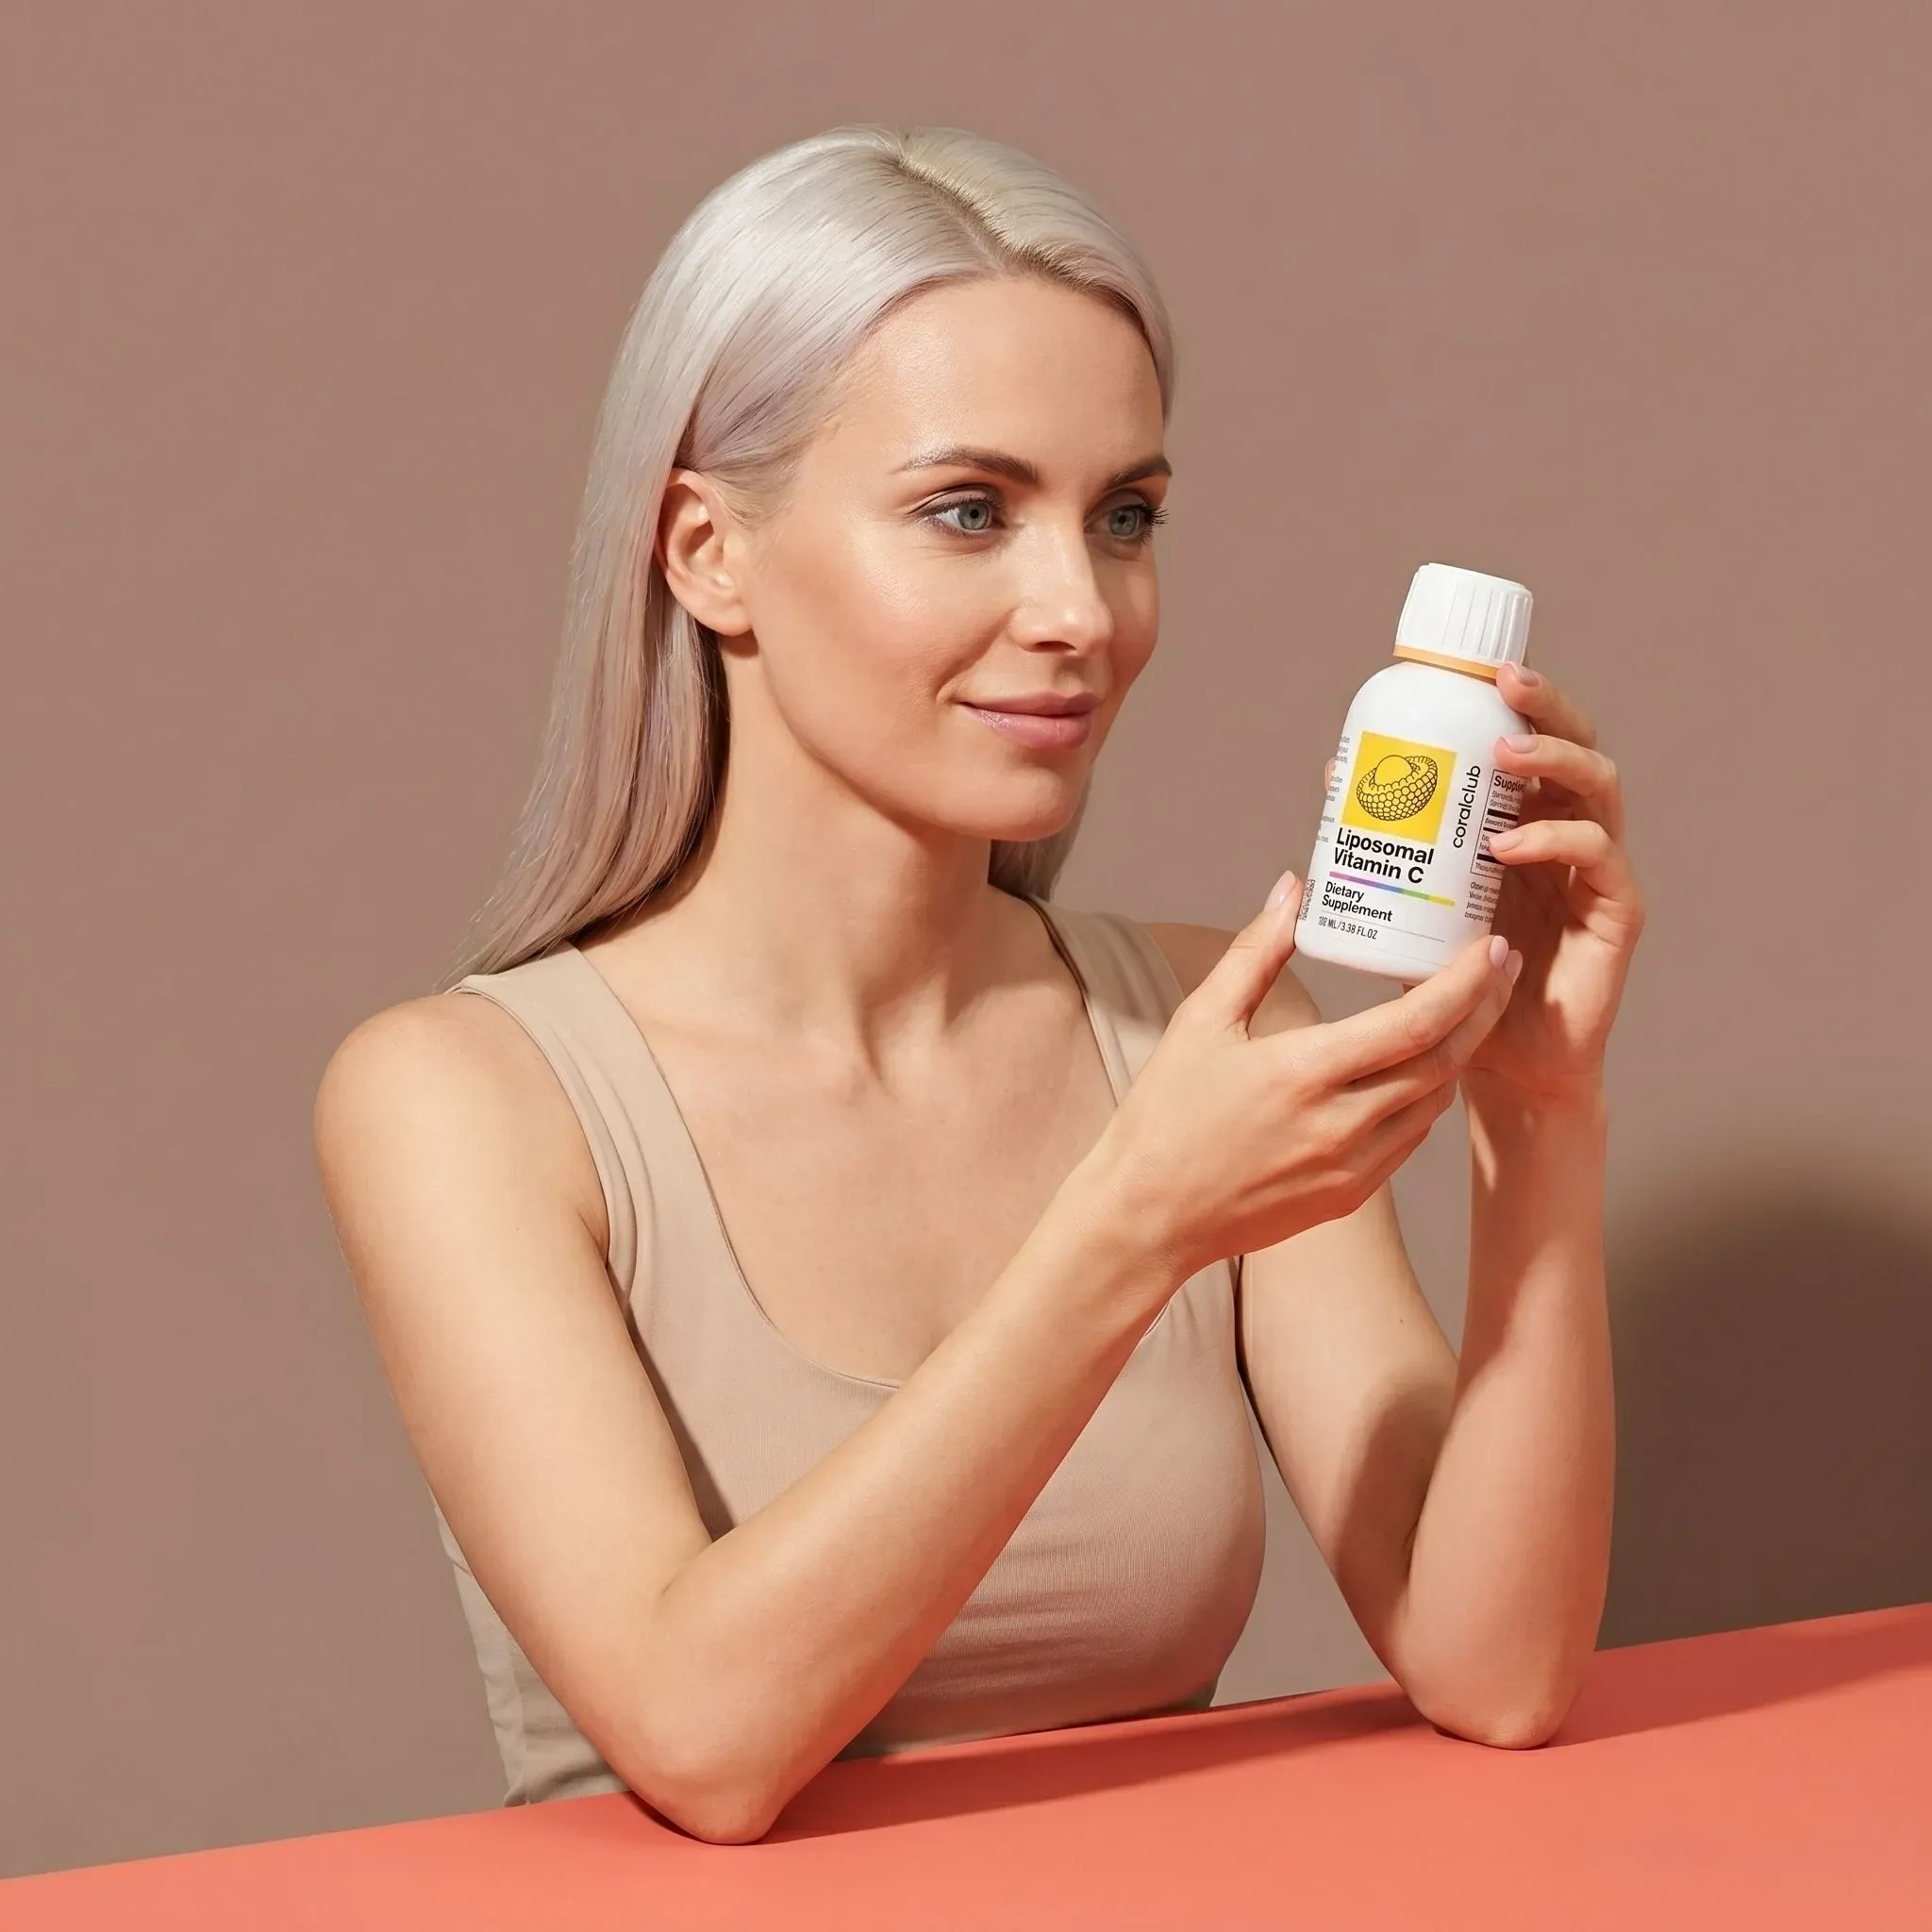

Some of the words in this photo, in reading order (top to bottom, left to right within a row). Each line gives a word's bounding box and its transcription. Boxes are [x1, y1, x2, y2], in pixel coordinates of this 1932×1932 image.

[1454, 765, 1481, 848] coralclub
[1337, 827, 1434, 865] Liposomal
[1334, 848, 1402, 879] Vitamin
[1407, 866, 1424, 884] C
[1322, 895, 1393, 923] Supplement
[1325, 881, 1364, 903] Dietary
